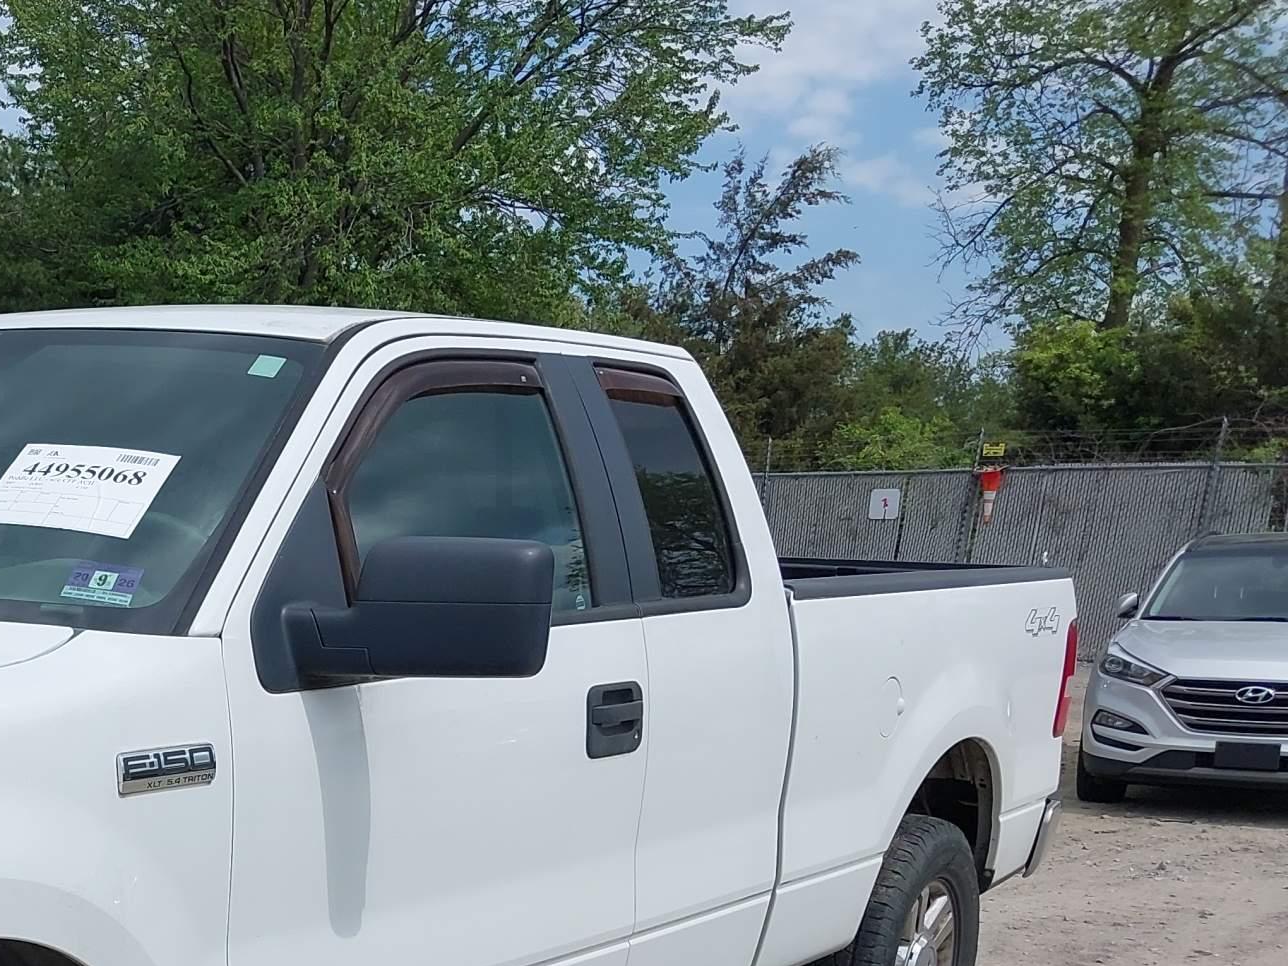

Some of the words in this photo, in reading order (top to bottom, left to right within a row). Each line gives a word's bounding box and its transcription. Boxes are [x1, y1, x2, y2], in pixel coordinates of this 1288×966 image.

[23, 461, 147, 486] 44955068
[73, 572, 90, 582] 20
[96, 573, 108, 587] 9
[118, 577, 136, 589] 26
[1024, 606, 1061, 637] 4x4
[146, 780, 163, 789] XLT
[183, 772, 215, 784] TRITON
